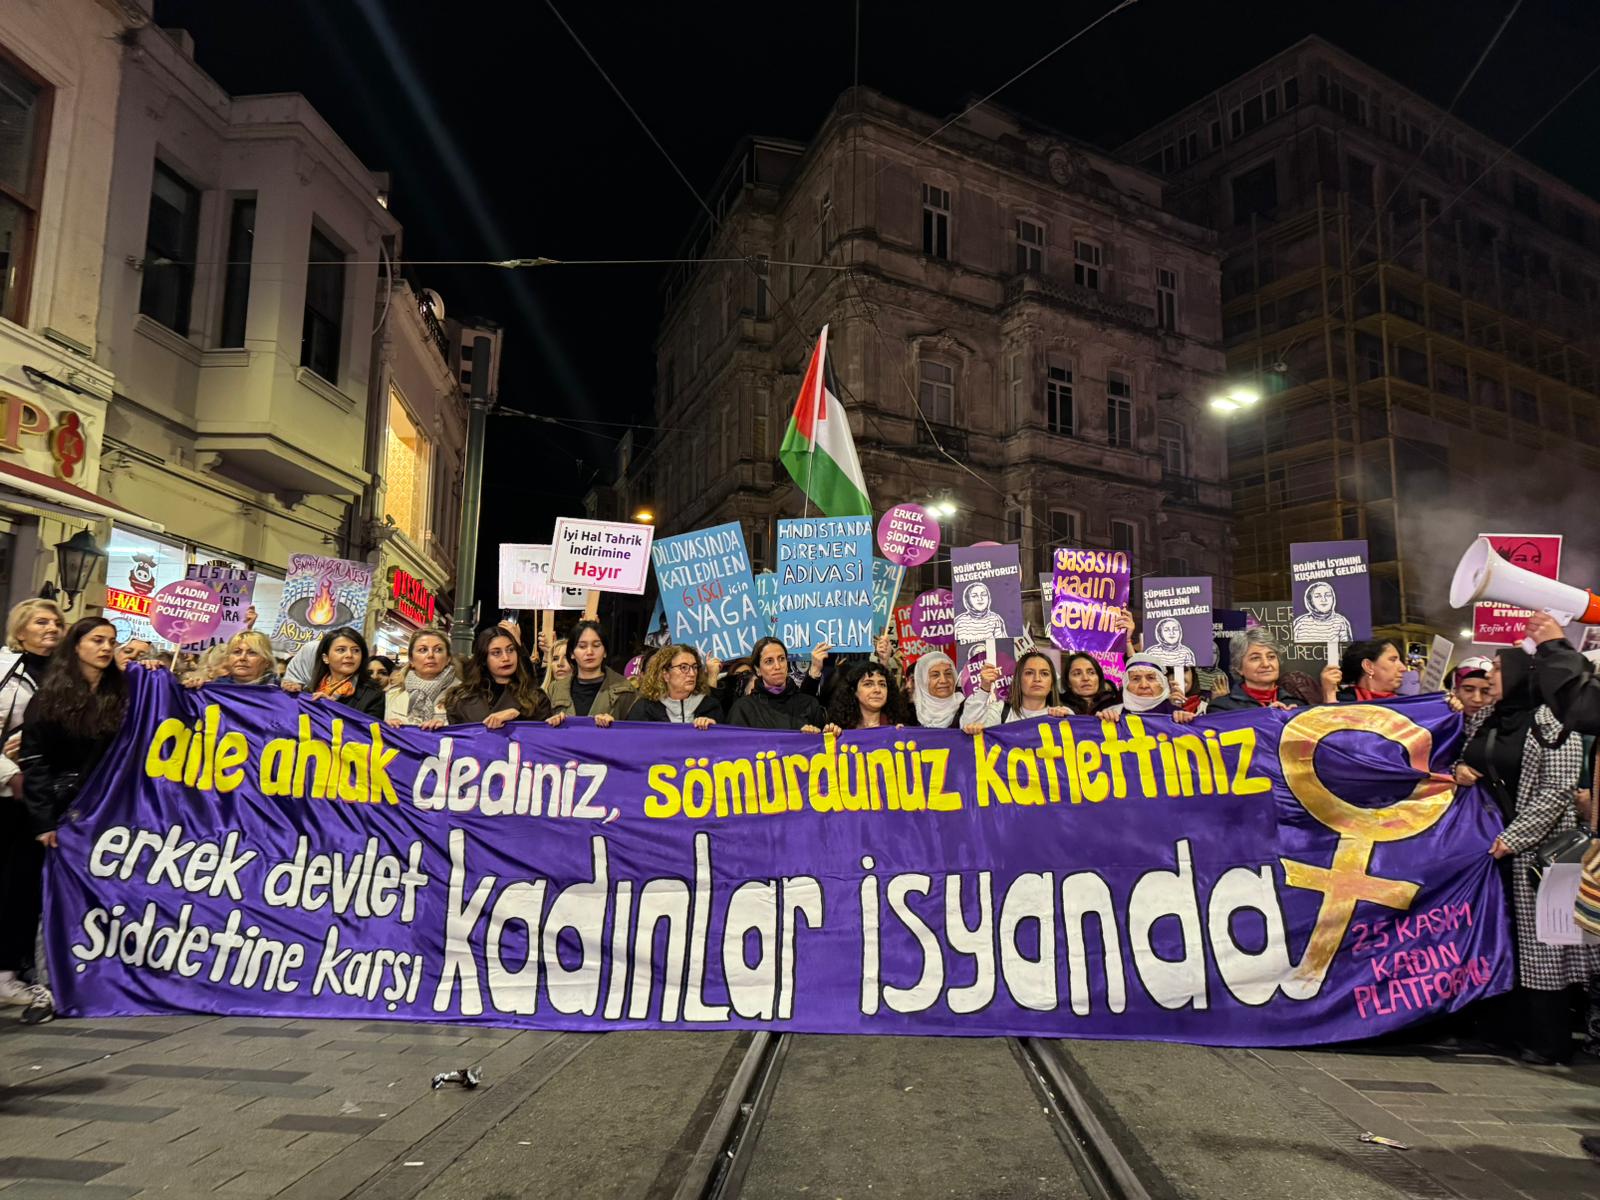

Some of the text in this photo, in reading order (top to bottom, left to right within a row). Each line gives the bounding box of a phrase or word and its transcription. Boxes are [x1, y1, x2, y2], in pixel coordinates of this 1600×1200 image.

[893, 508, 924, 523] ERKEK
[563, 527, 642, 547] İyi Hal Tahrik
[889, 521, 926, 535] DEVLET
[883, 542, 905, 554] SON
[886, 531, 936, 550] ŞİDDETİNE
[569, 543, 631, 560] İndirimine
[780, 541, 858, 561] DİRENEN
[573, 561, 622, 580] Hayır
[659, 552, 746, 591] KATLEDİLEN
[953, 560, 991, 574] ROJİN'DEN
[1056, 550, 1128, 574] yaşasın
[1293, 555, 1361, 573] ROJİN'İN İSYANINI
[784, 560, 865, 585] ADİVASİ
[954, 565, 1018, 583] VAZGEÇMİYORUZ!
[1294, 563, 1368, 582] KUŞANDIK GELDİK!
[175, 586, 209, 600] KADIN
[682, 587, 695, 608] 6
[1054, 575, 1116, 600] kadın
[1144, 585, 1200, 599] ŞÜPHELİ KADIN
[156, 593, 220, 614] CİNAYETLERİ
[779, 589, 872, 612] KADINLARINA
[1145, 596, 1190, 609] ÖLÜMLERİNİ
[156, 605, 210, 624] POLİTİKTİR
[1050, 601, 1127, 634] devrim
[1146, 604, 1210, 619] AYDINLATACAĞIZ!
[783, 620, 811, 648] BİN
[815, 618, 872, 647] SELAM
[921, 624, 954, 638] AZAD
[145, 703, 1273, 825] aile ahlak dediniz, sömürdünüz katlettiniz
[88, 824, 430, 923] erkek devlet
[860, 837, 1326, 1016] isyanda
[1351, 901, 1474, 953] 25 KASIM
[71, 903, 424, 1012] şiddetine karşı
[1371, 941, 1462, 982] KADIN
